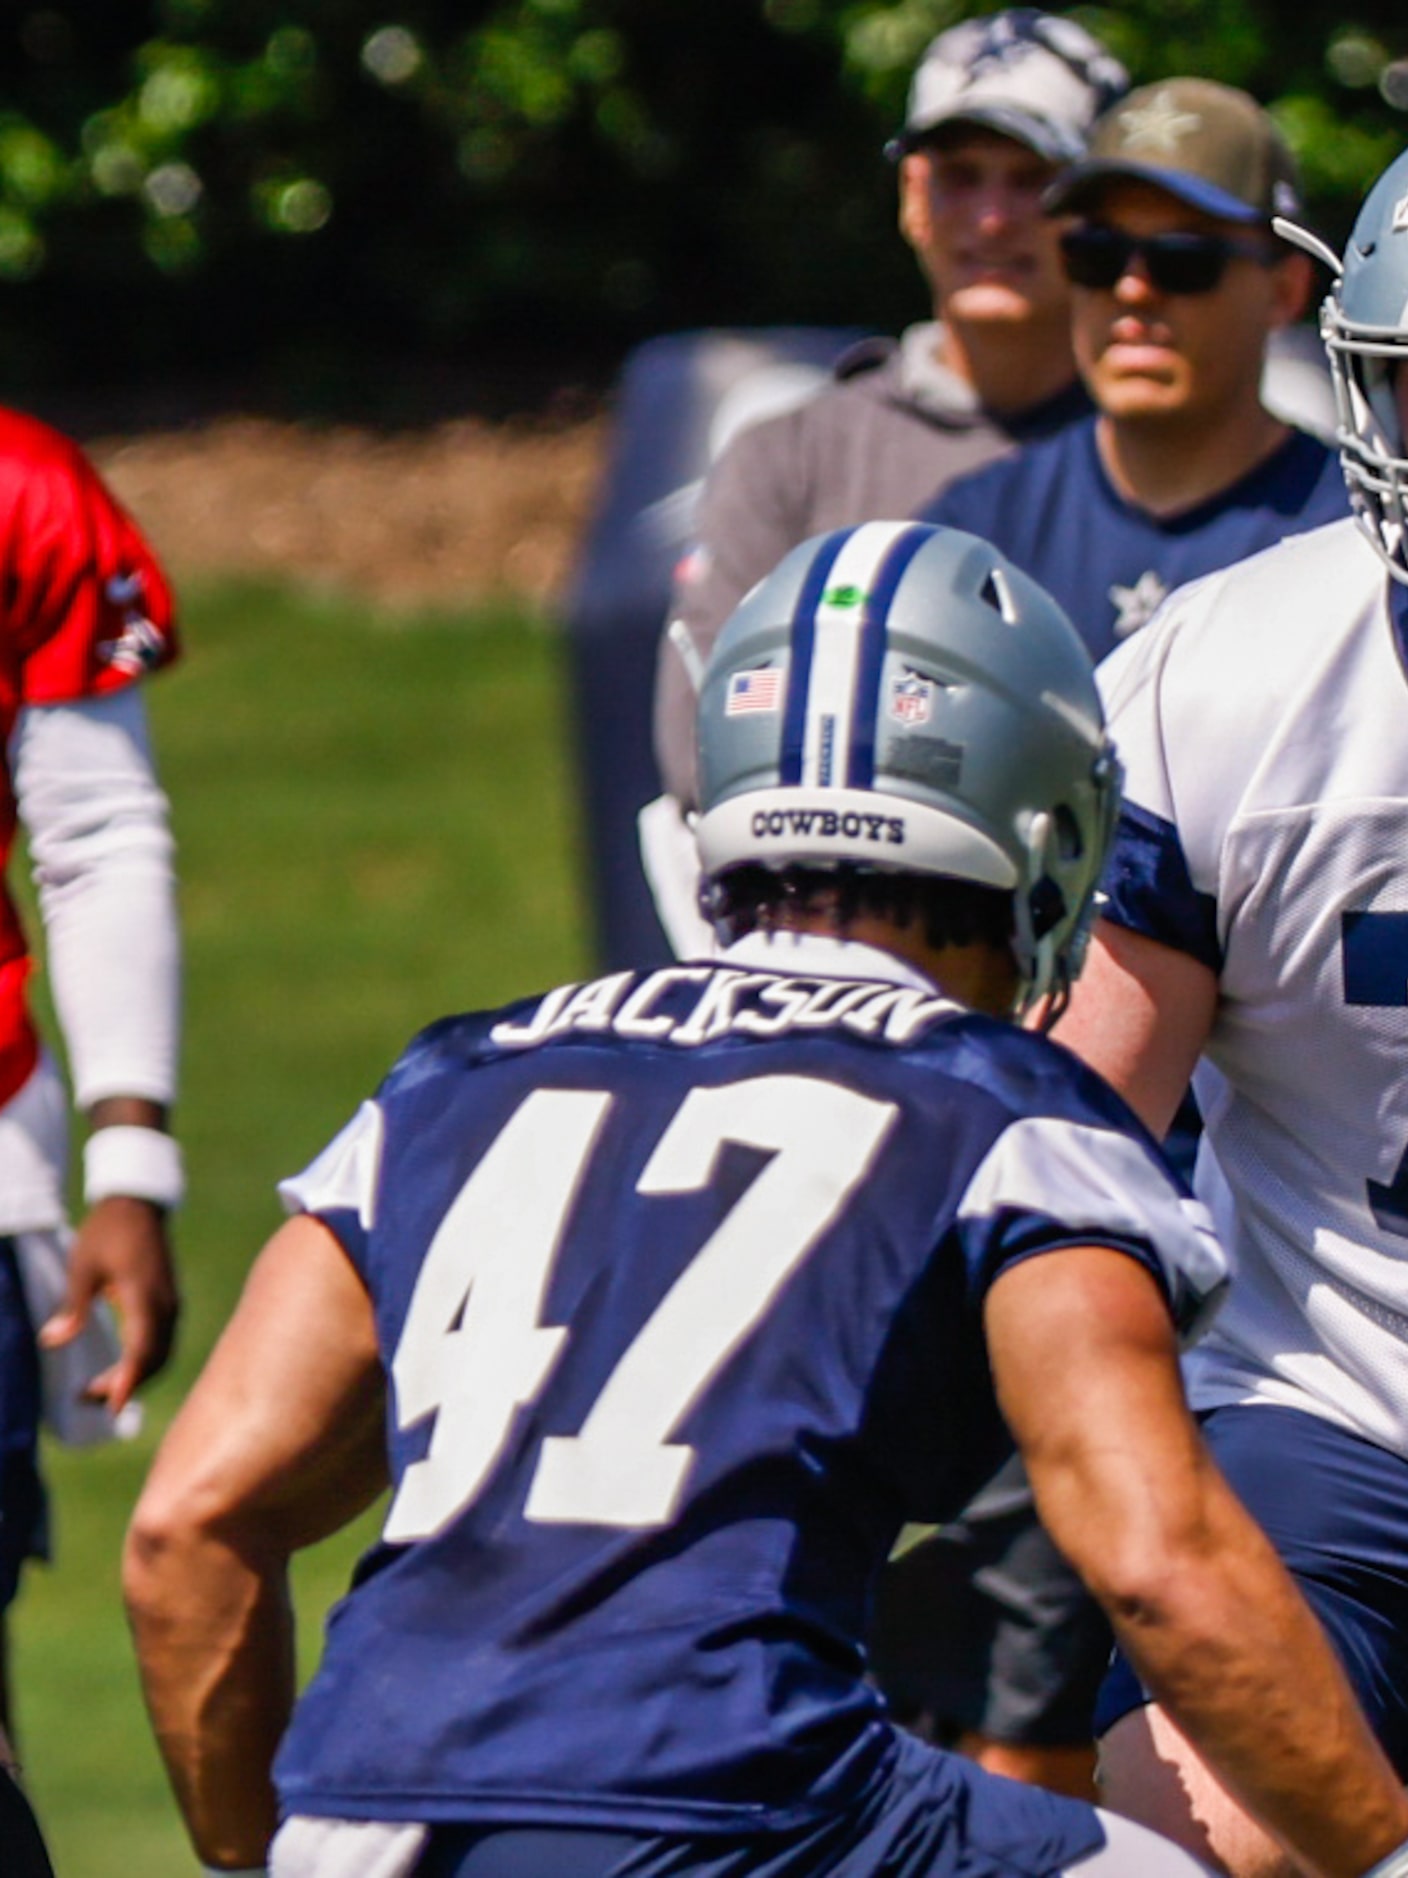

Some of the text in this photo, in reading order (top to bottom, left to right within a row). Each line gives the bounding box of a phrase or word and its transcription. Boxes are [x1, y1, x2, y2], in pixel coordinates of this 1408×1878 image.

[752, 810, 904, 844] COWBOYS
[490, 966, 965, 1047] JACKSON
[383, 1075, 899, 1545] 47
